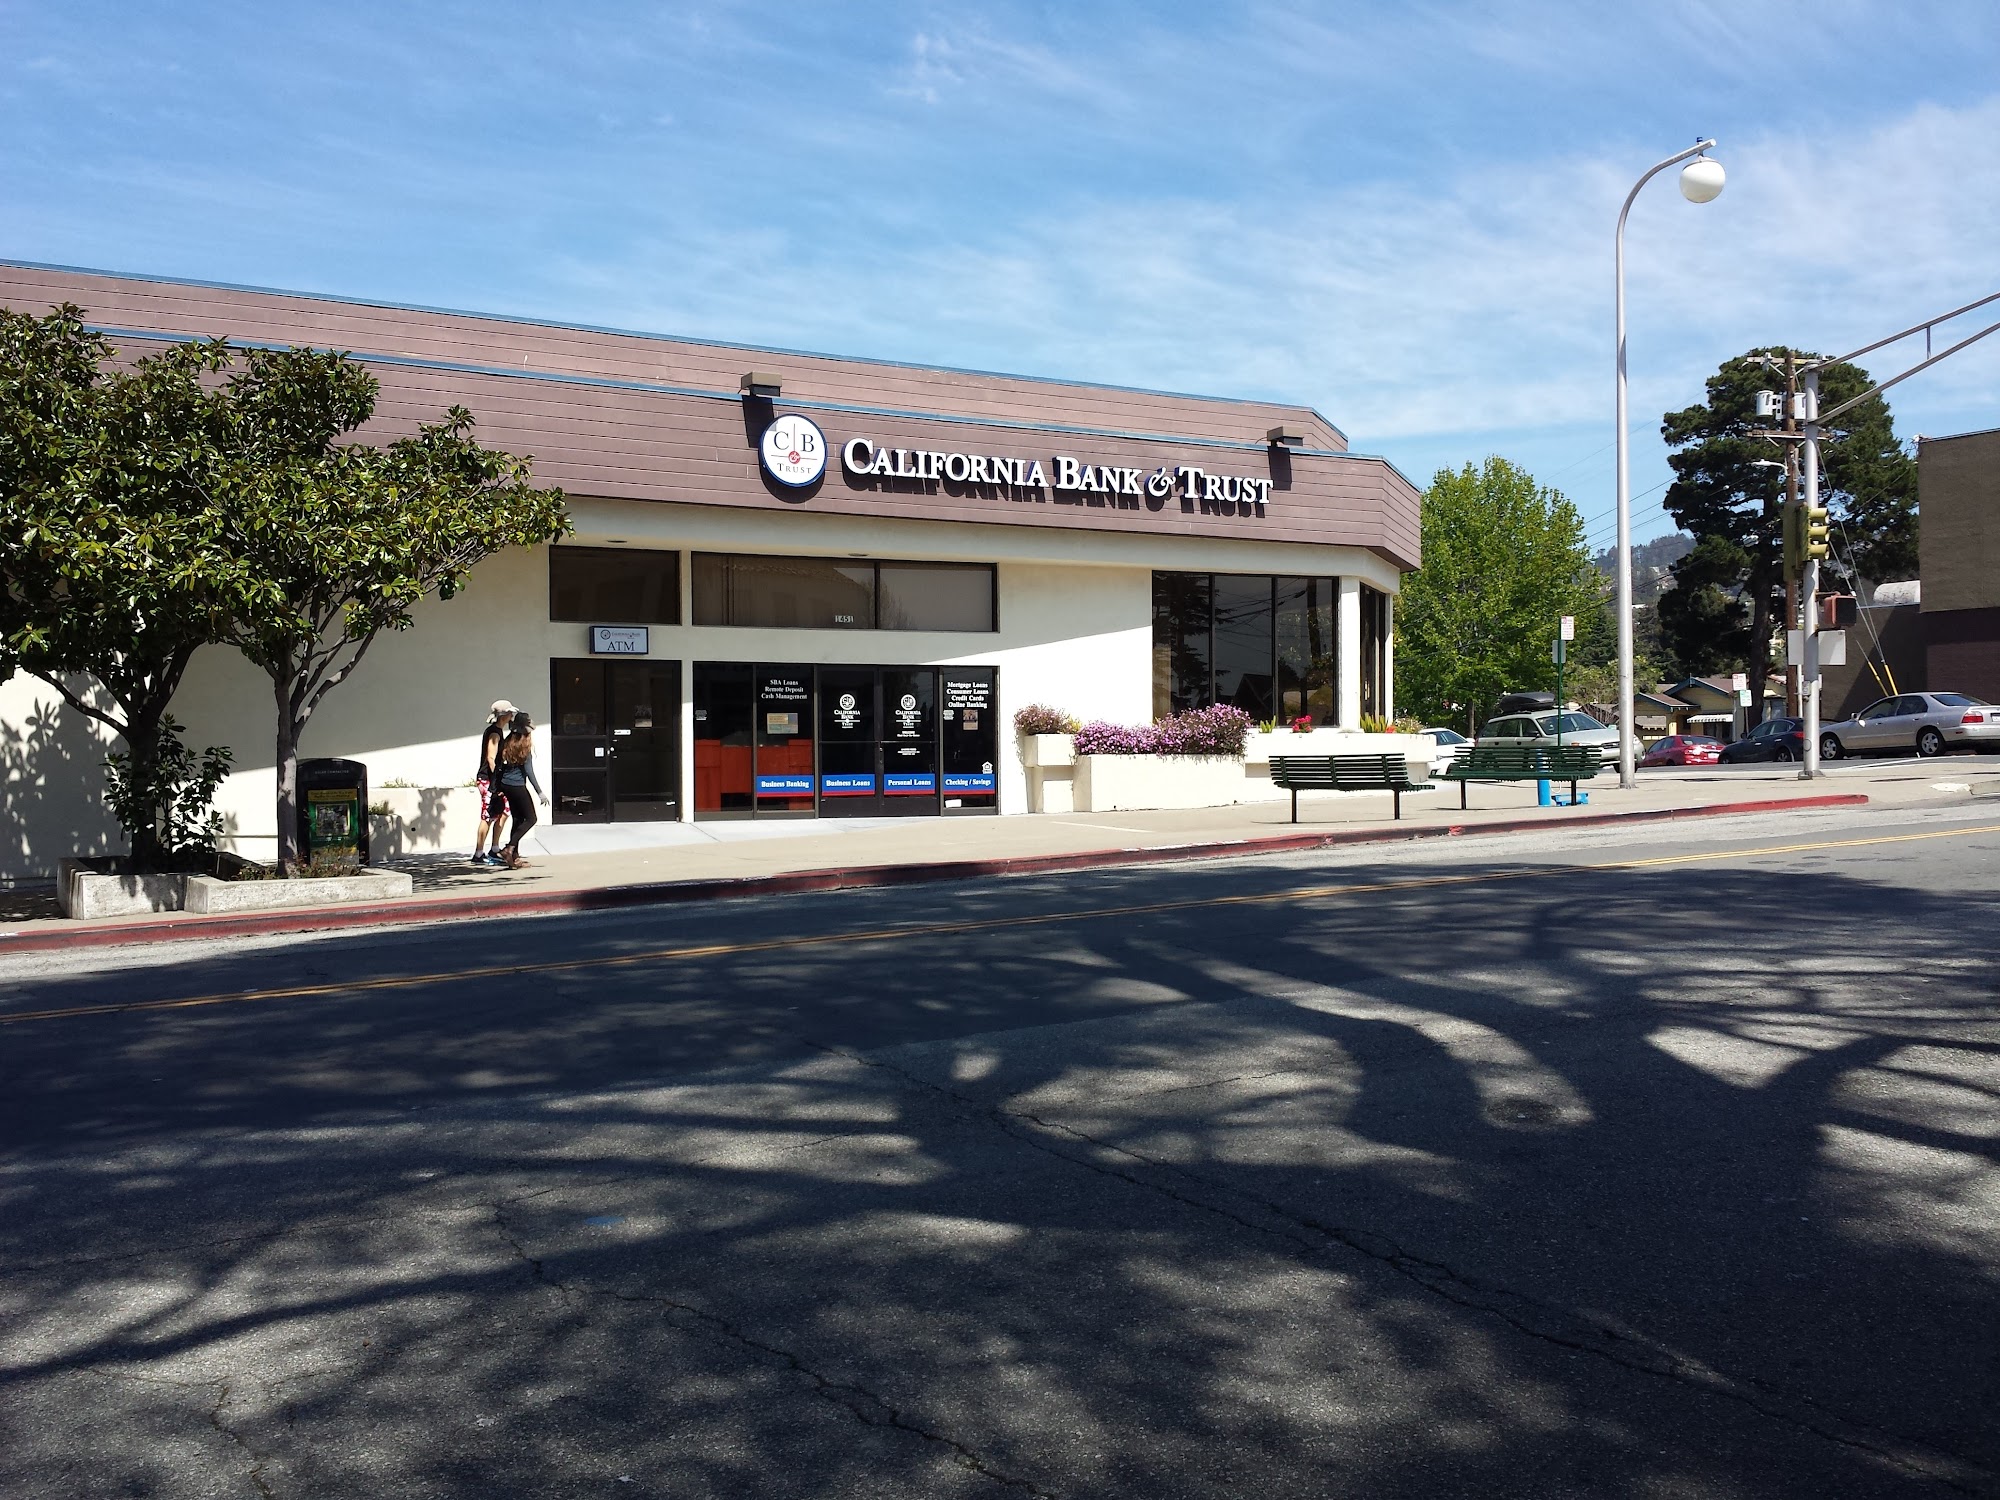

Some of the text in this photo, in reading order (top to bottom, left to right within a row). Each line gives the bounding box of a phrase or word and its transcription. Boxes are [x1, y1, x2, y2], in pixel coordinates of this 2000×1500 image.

[774, 431, 814, 452] C B
[777, 463, 811, 474] TRUST
[843, 437, 1273, 503] CALIFORNIA BANK & TRUST
[607, 641, 635, 651] ATM
[947, 681, 971, 689] Mortgage
[786, 780, 810, 788] Banking
[945, 778, 968, 786] Checking
[972, 778, 991, 786] Savings
